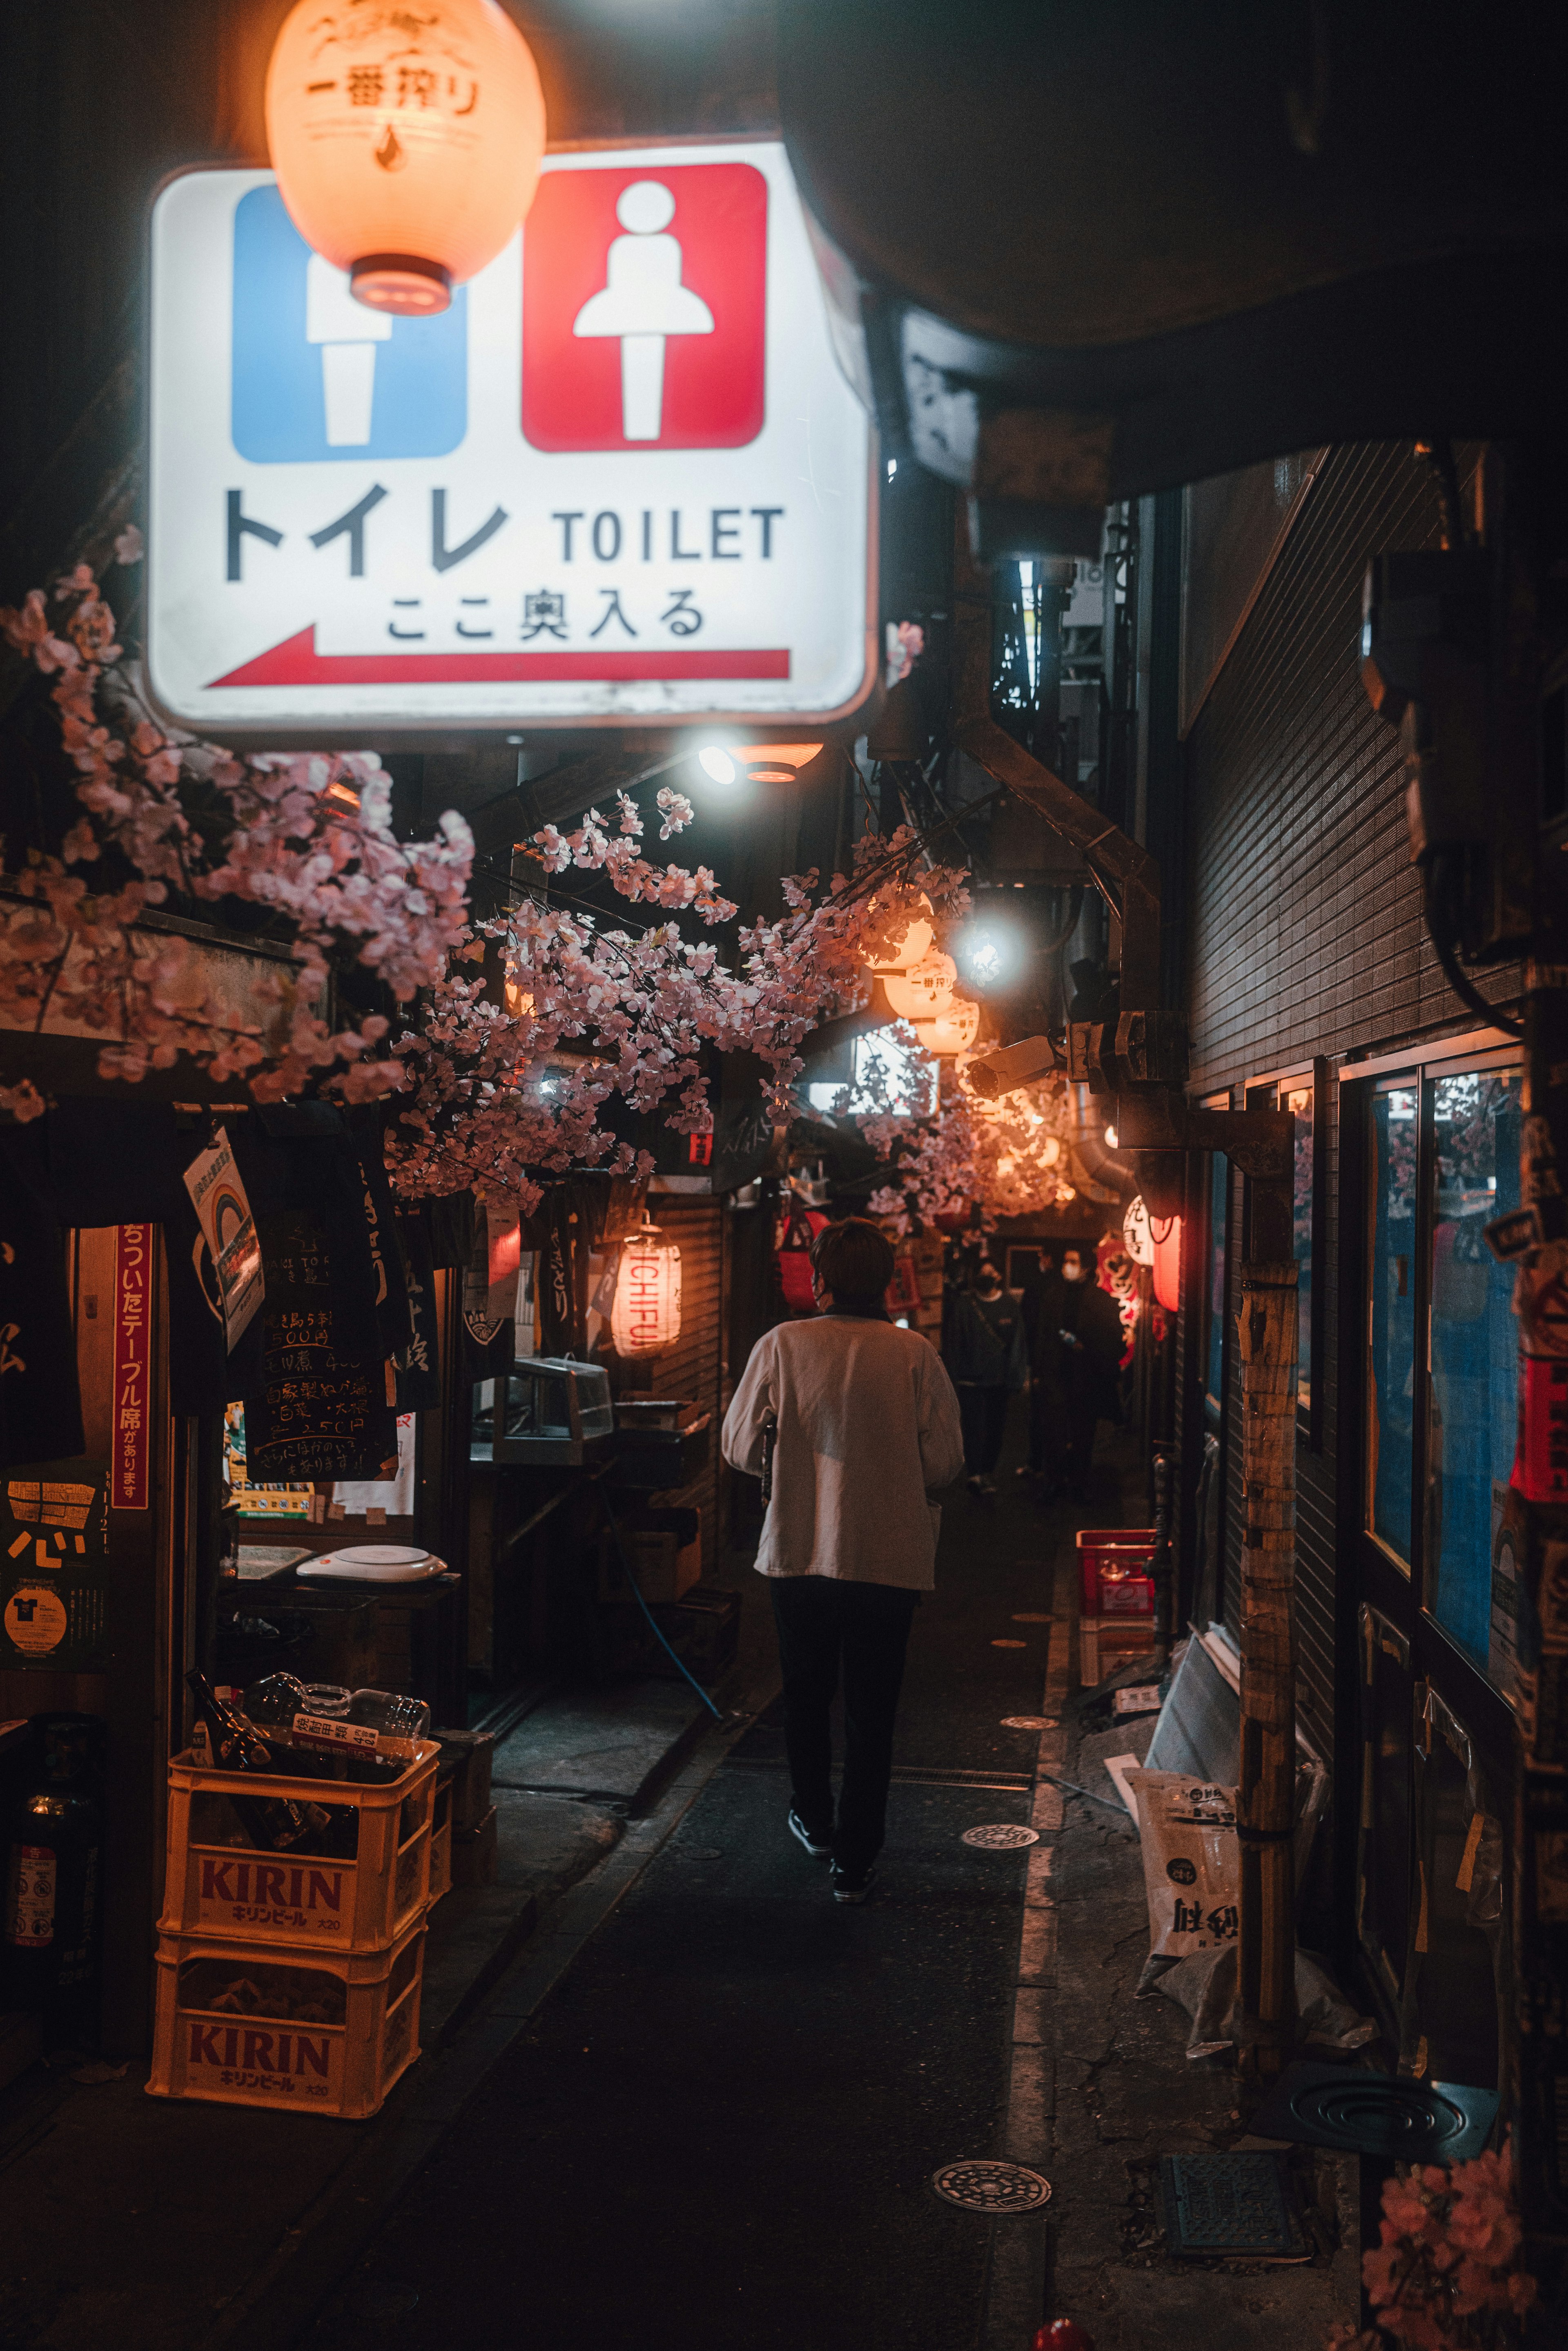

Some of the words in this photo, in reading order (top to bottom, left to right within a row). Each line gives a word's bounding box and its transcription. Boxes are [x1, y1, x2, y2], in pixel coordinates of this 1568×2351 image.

[307, 65, 477, 115] 一番搾り
[225, 482, 509, 583] トイレ
[552, 508, 783, 564] TOILET
[388, 587, 706, 642] ここ奥入る
[295, 1718, 348, 1739] 焼酎甲類
[200, 1858, 343, 1912] KIRIN
[232, 1905, 307, 1928] キリンビール
[189, 2023, 328, 2079] KIRIN
[220, 2069, 294, 2092] キリンビール
